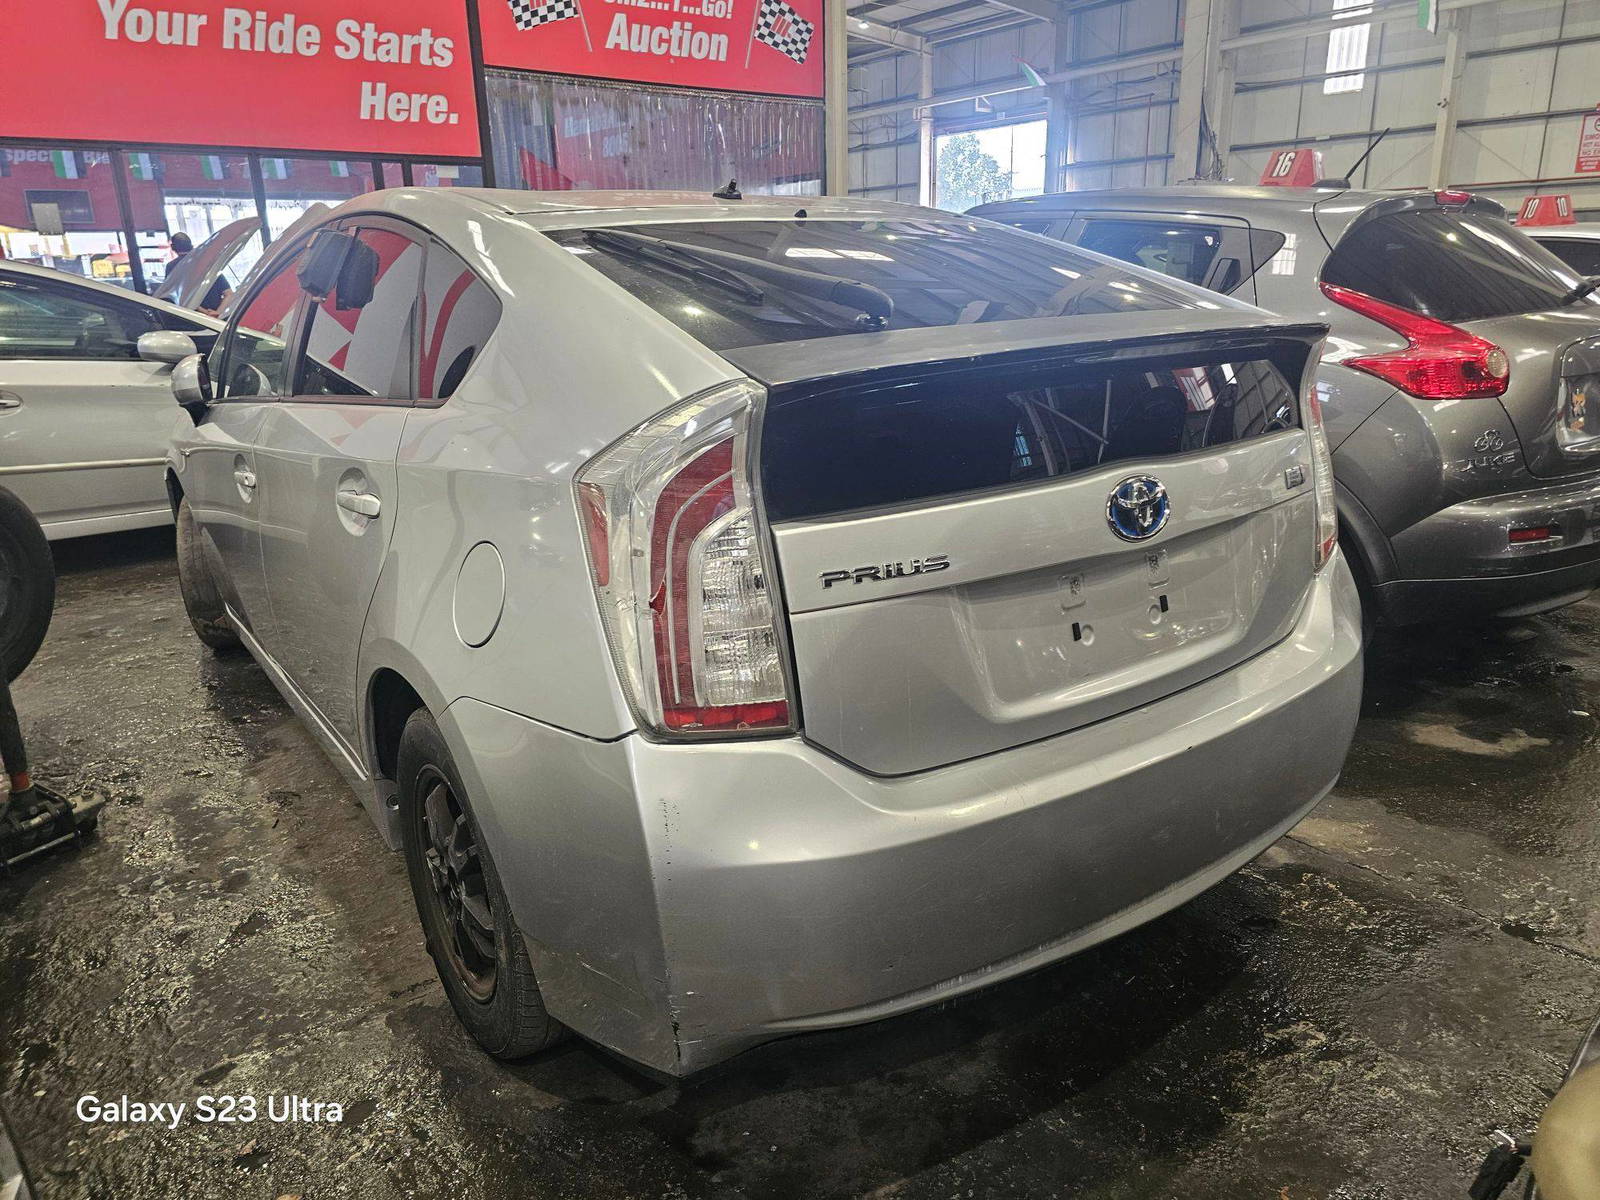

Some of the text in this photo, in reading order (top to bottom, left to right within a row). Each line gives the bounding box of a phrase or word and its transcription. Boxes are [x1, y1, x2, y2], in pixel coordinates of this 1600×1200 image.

[97, 0, 454, 67] Your Ride Starts
[605, 12, 729, 61] Auction
[360, 81, 458, 124] Here.
[1271, 151, 1296, 177] 16
[1523, 198, 1540, 219] 10
[1556, 197, 1569, 217] 10
[1455, 451, 1515, 473] JUKE
[820, 553, 950, 589] PRIUS
